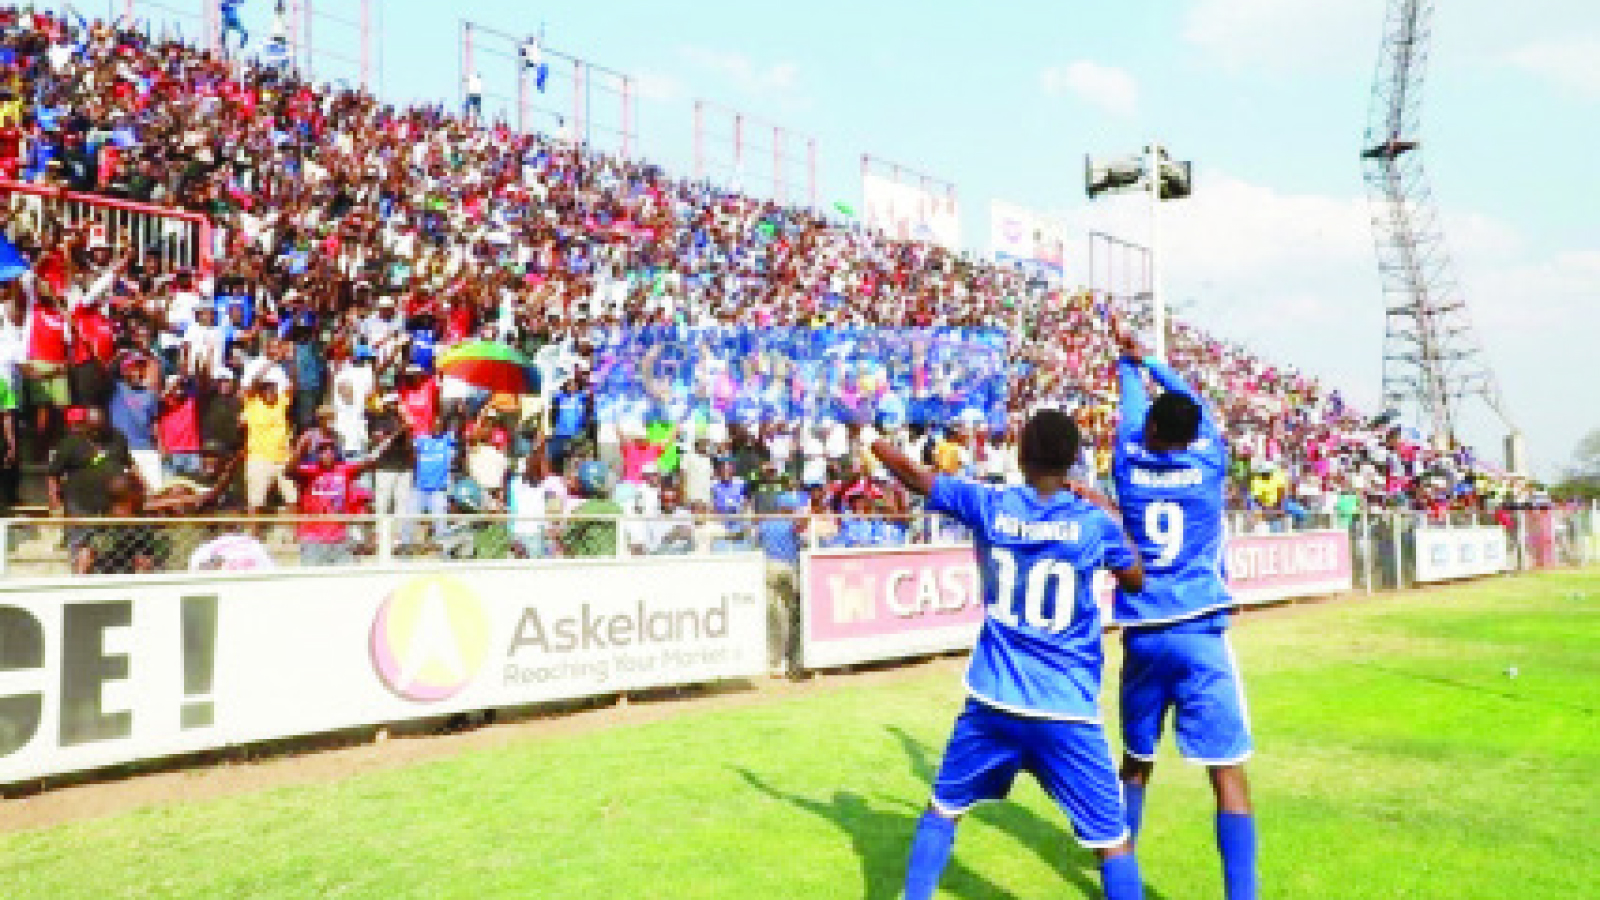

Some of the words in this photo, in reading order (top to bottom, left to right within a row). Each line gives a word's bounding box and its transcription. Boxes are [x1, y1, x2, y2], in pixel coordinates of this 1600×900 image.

[1145, 502, 1183, 566] 9
[986, 547, 1076, 634] 10
[506, 595, 729, 657] Askeland
[503, 660, 609, 687] Reaching
[612, 651, 654, 673] Your
